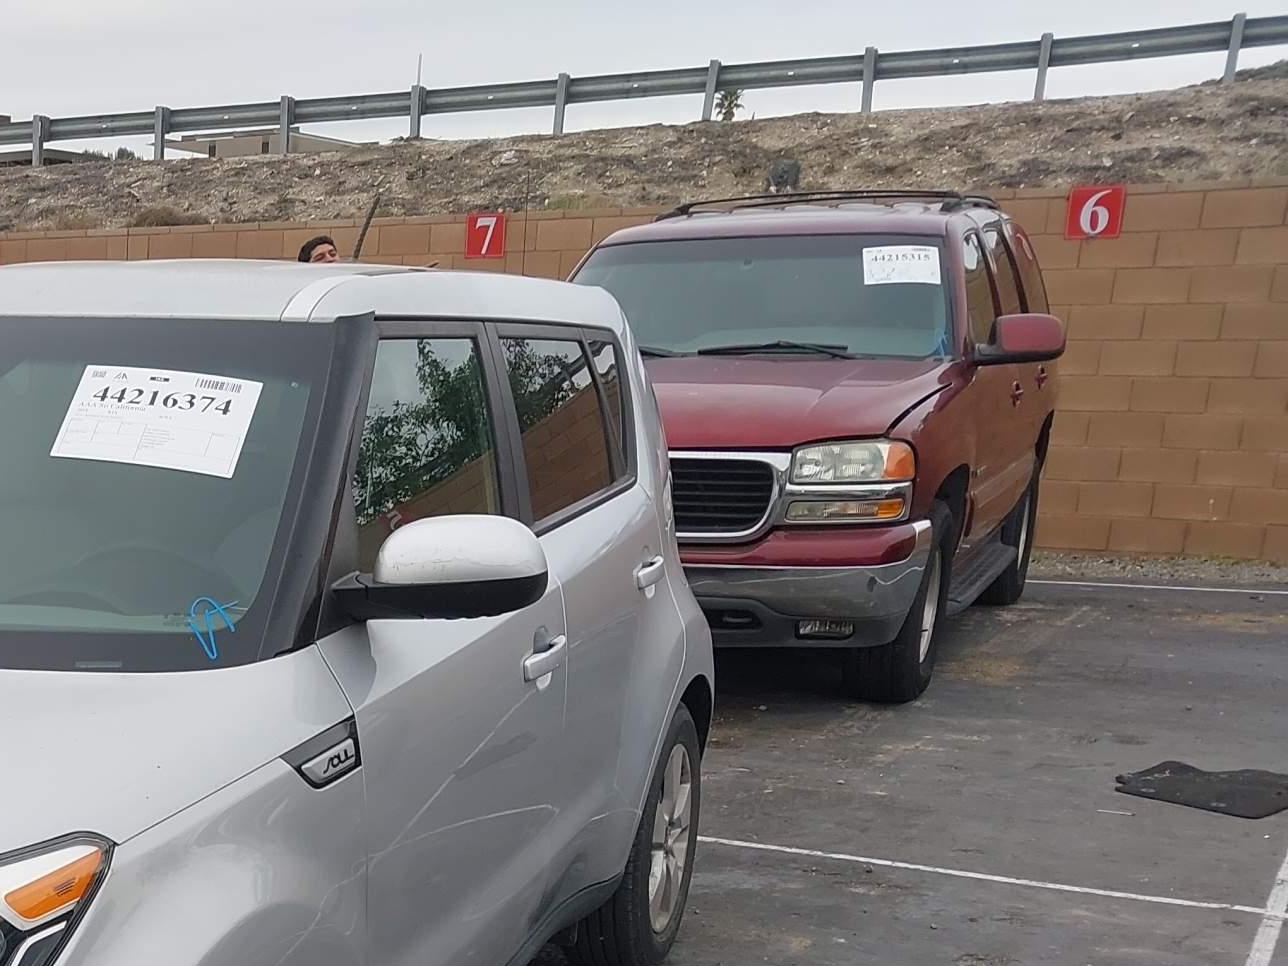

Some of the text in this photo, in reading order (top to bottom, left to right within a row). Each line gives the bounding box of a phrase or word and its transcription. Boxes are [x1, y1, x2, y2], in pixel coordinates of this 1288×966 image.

[1080, 189, 1113, 236] 6
[475, 217, 497, 255] 7
[93, 386, 233, 416] 44216374
